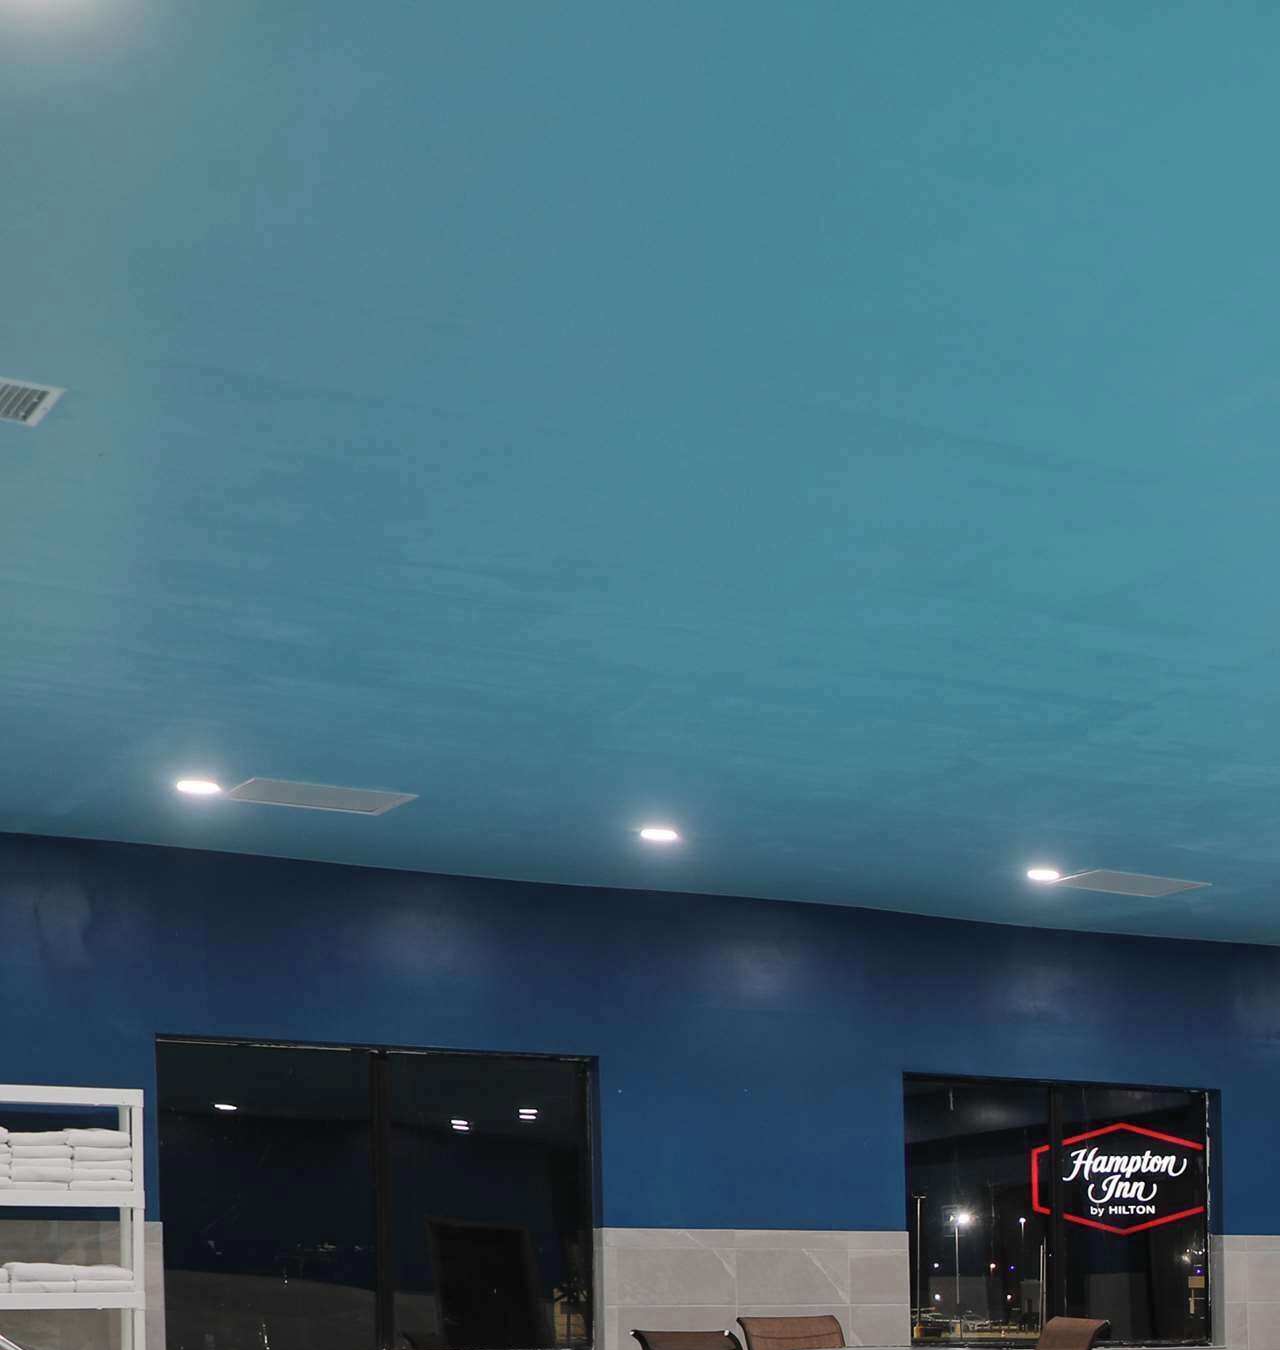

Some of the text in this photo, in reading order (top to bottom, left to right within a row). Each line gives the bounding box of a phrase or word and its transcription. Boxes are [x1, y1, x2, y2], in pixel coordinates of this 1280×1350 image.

[1062, 1147, 1188, 1182] Hampton
[1087, 1174, 1158, 1204] Inn
[1090, 1205, 1156, 1217] by HILTON
